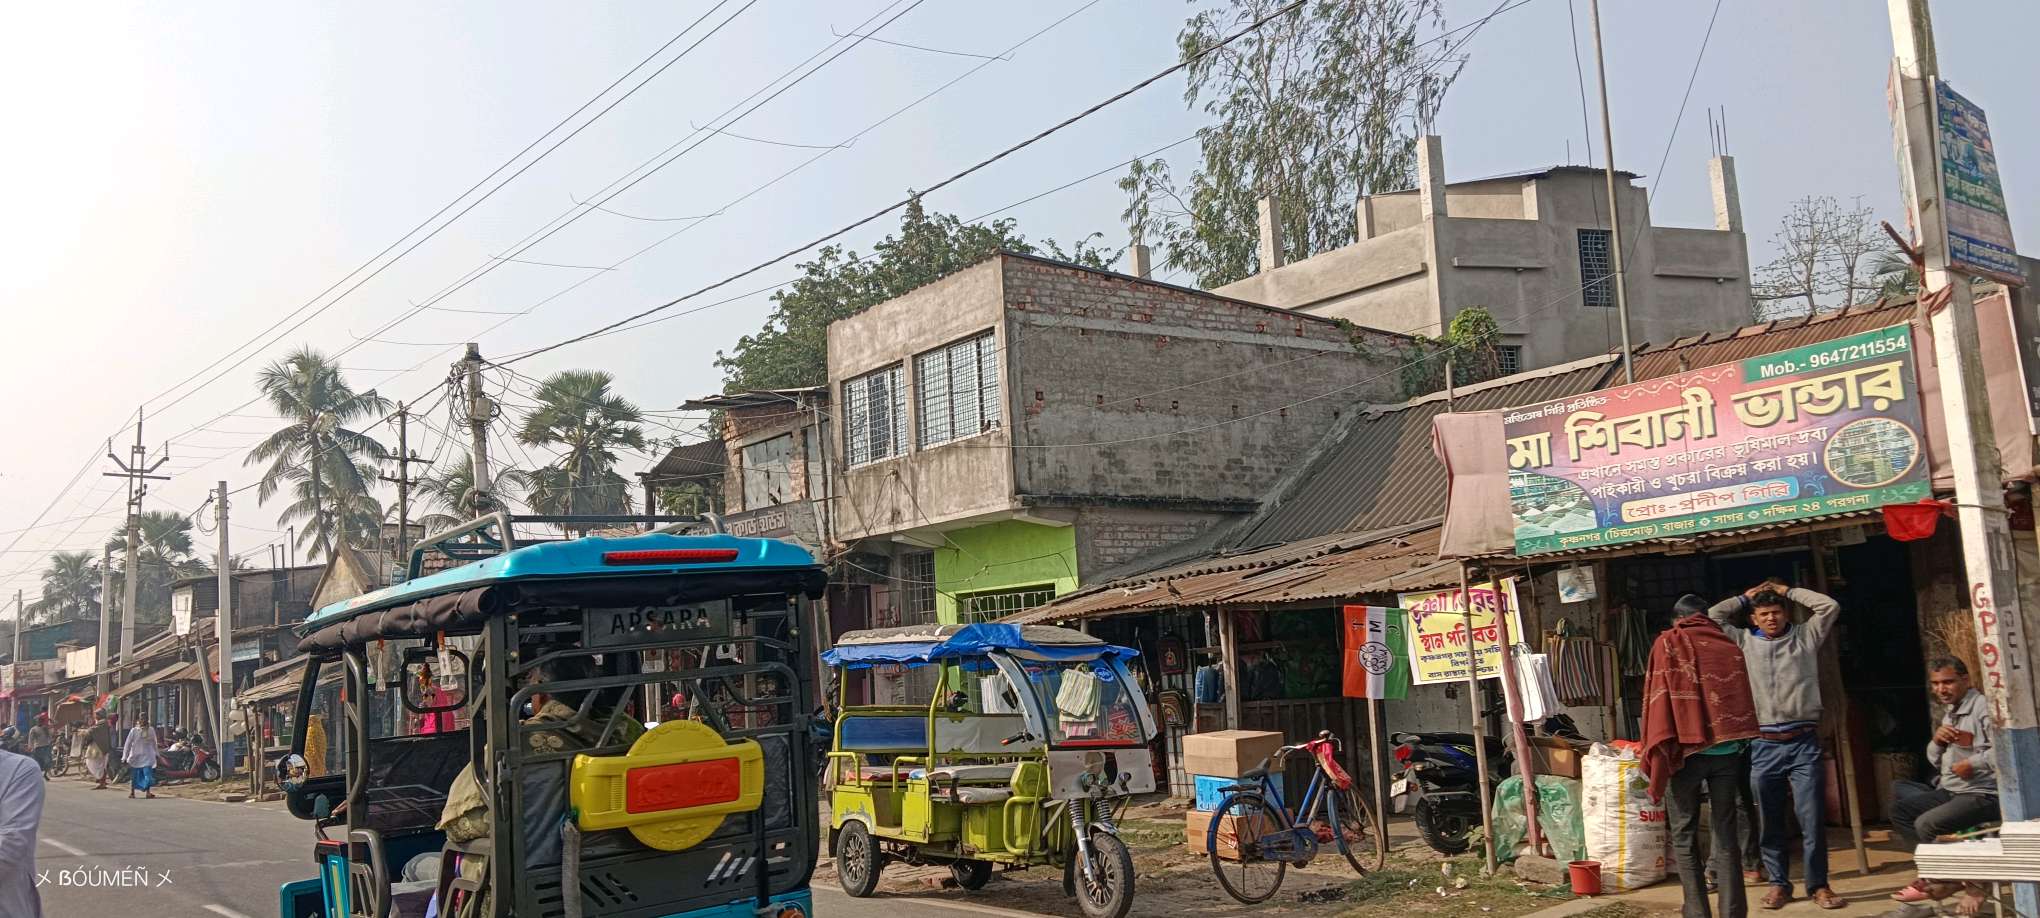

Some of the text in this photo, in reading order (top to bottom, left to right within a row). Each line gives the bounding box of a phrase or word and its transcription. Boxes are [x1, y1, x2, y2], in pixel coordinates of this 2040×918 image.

[1810, 335, 1907, 368] 9647211554
[1507, 360, 1906, 469] মা শিবানী ভান্ডার
[1544, 403, 1565, 417] গিরি
[1578, 463, 1622, 481] এখানে
[1626, 456, 1660, 473] সমস্ত
[1665, 447, 1725, 467] প্রকারের
[1591, 477, 1647, 500] পাইকারী
[1650, 479, 1662, 489] ও
[1667, 470, 1702, 491] খুচরা
[1705, 462, 1748, 482] বিক্রয়
[1752, 458, 1782, 474] করা
[1742, 481, 1791, 502] গিরি
[1662, 519, 1696, 532] বাজার
[1712, 512, 1745, 525] সাগর
[1801, 500, 1821, 512] ২৪
[1826, 493, 1870, 508] পরগনা
[610, 608, 712, 635] APSARA
